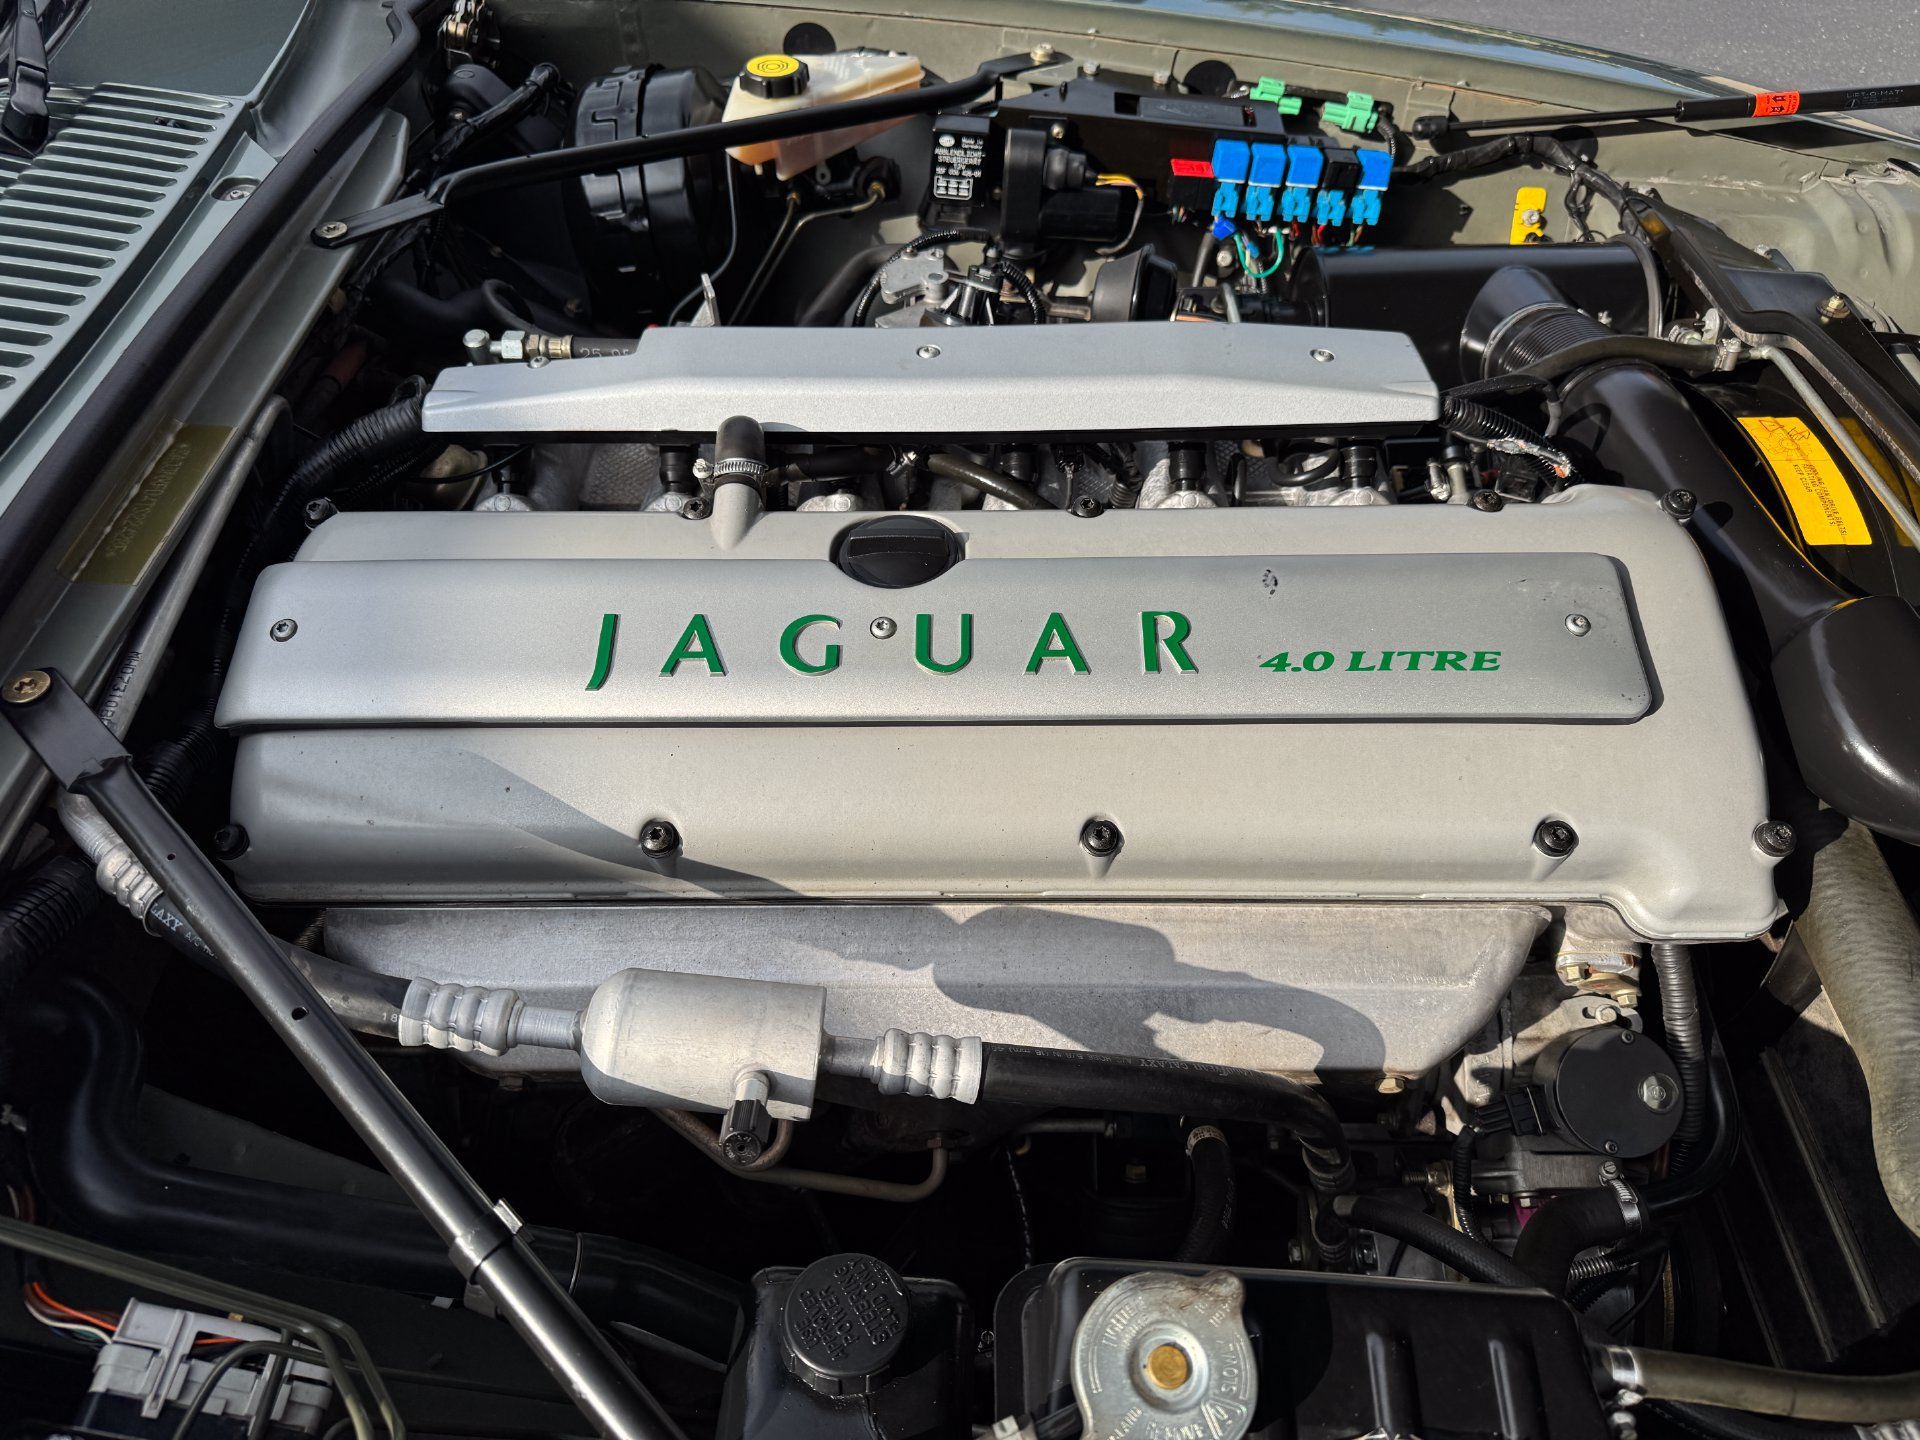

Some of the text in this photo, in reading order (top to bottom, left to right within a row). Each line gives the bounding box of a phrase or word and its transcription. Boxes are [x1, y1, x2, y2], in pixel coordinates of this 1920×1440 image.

[585, 611, 1199, 691] JAGUAR
[1259, 650, 1502, 672] 4.0 LITRE
[1140, 1059, 1189, 1070] GALAXY
[817, 1285, 860, 1347] POWER
[832, 1264, 889, 1346] STEERING
